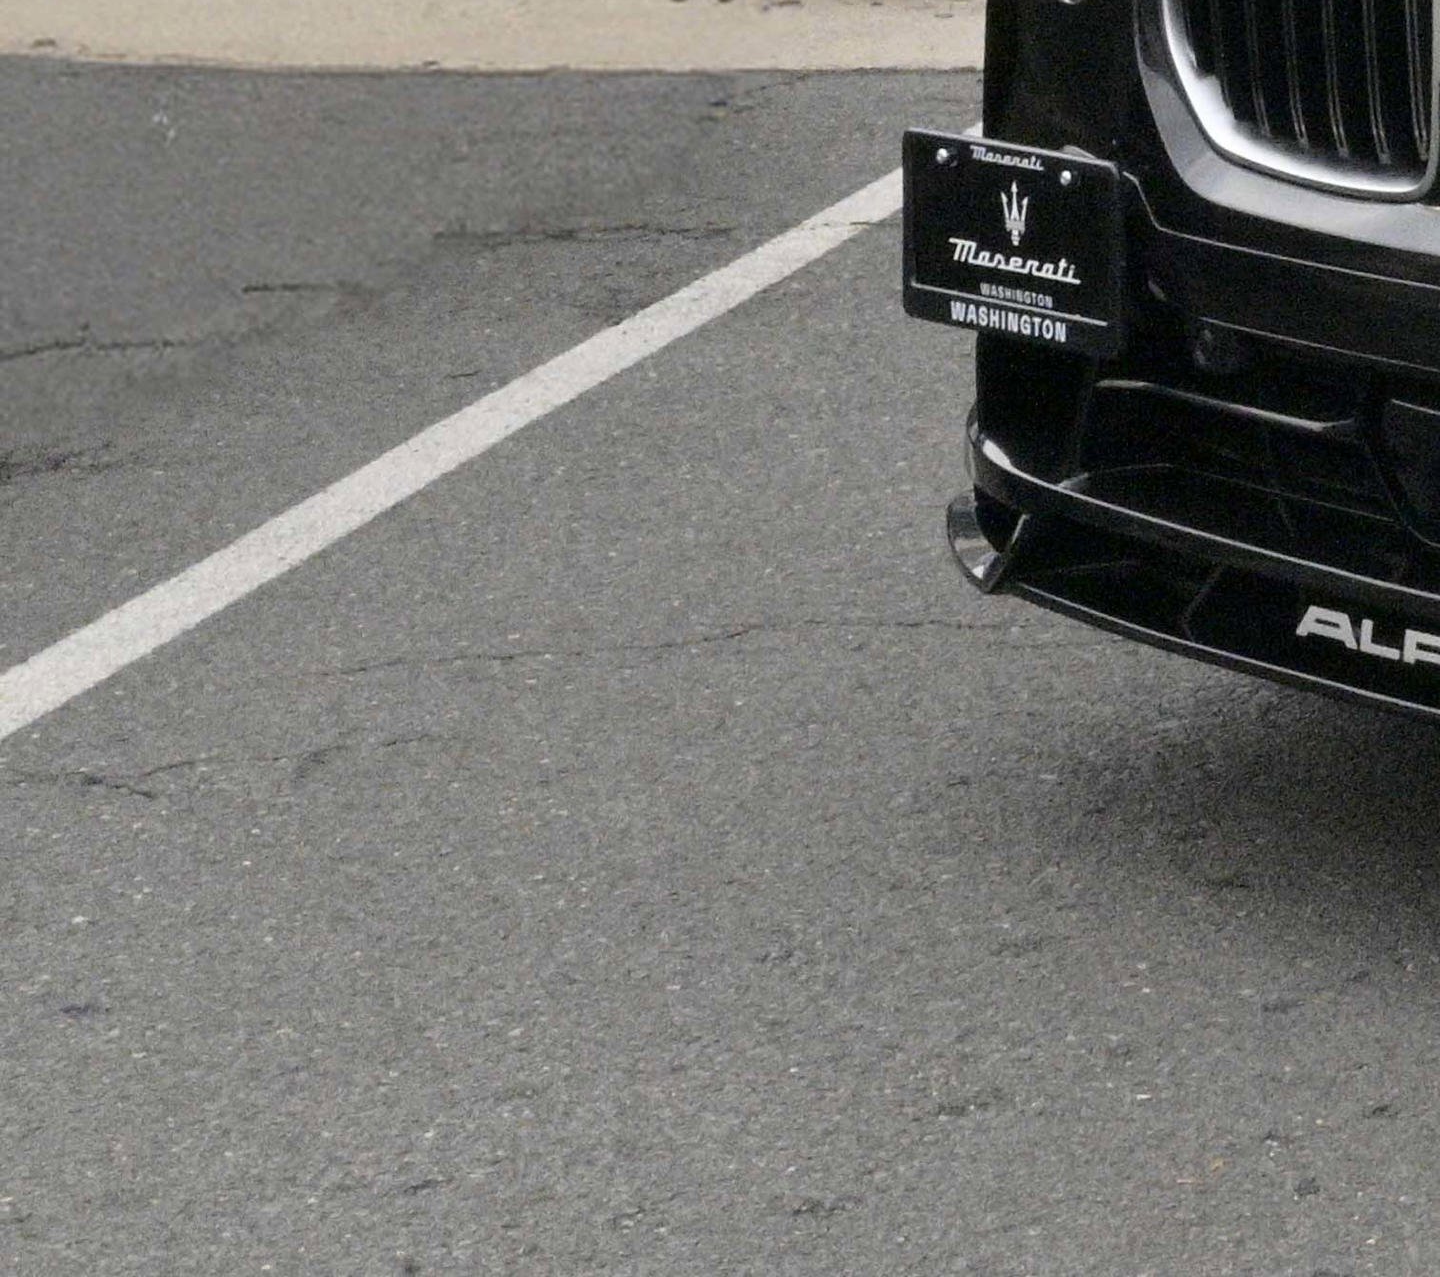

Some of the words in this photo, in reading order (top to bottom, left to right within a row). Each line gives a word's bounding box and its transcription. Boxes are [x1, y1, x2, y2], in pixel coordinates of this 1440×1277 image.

[970, 145, 1044, 171] Maserati
[949, 237, 1081, 285] Maserati
[980, 283, 1053, 309] WASHINGTON
[951, 300, 1067, 343] WASHINGTON
